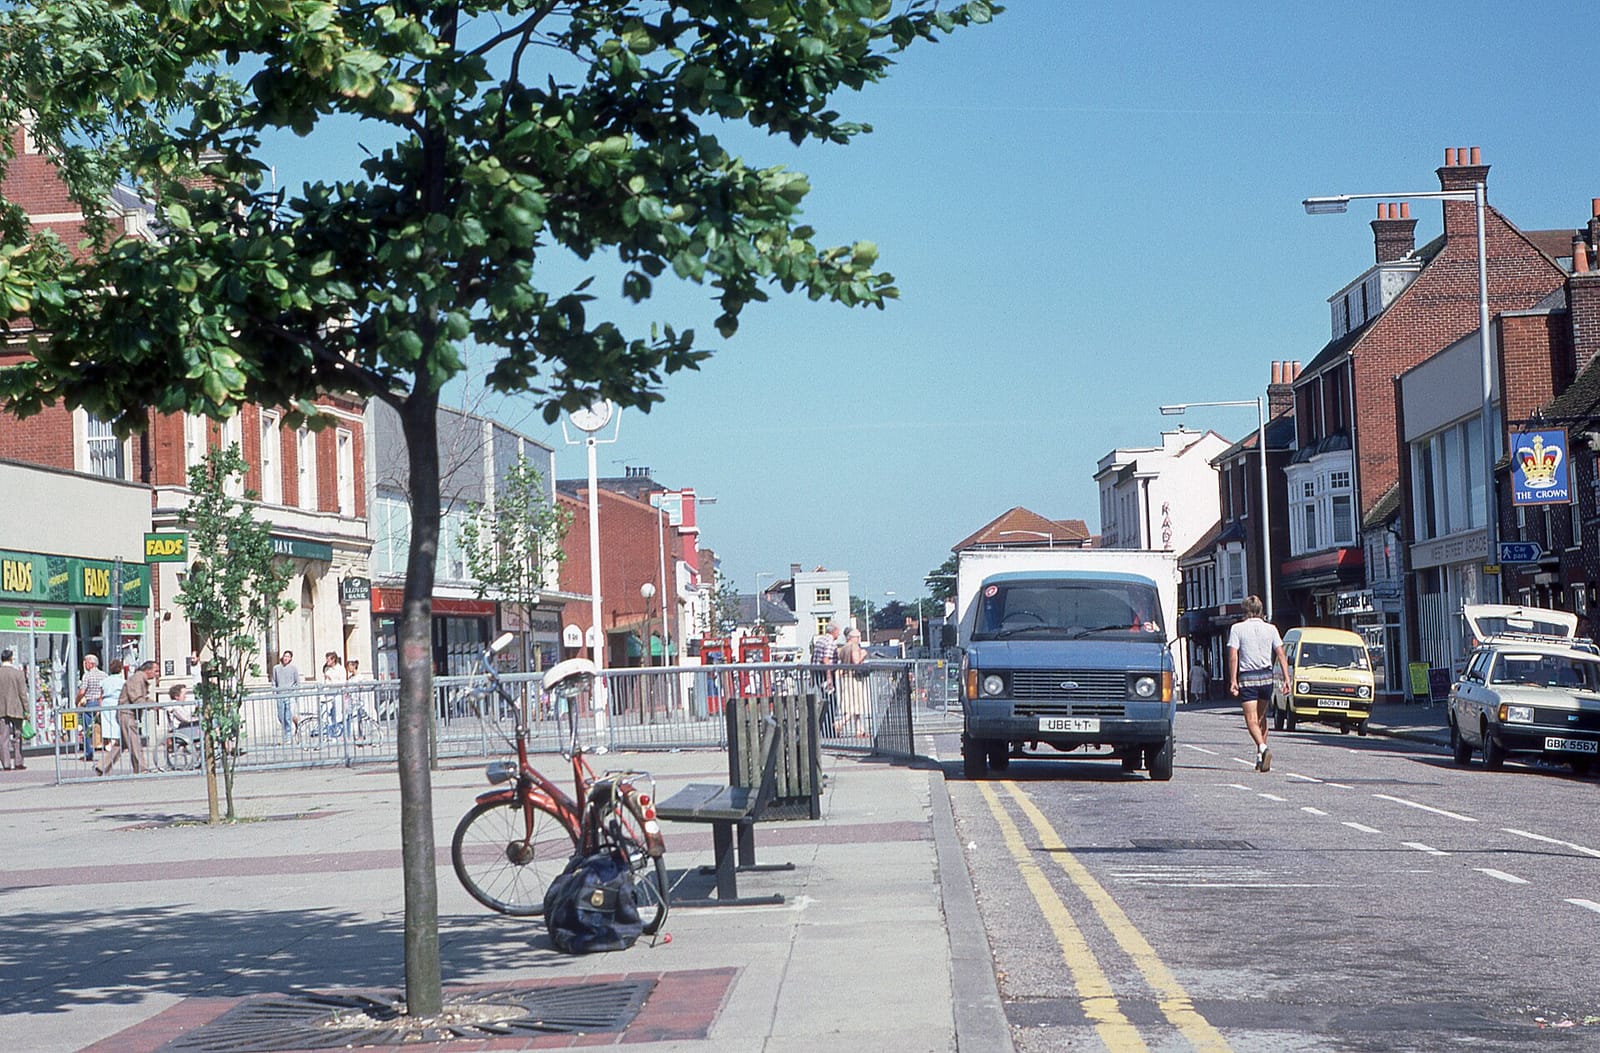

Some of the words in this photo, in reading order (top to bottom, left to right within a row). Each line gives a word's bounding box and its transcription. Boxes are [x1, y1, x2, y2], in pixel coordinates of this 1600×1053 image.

[1516, 491, 1533, 500] THE
[1536, 489, 1568, 499] CROWN
[146, 539, 183, 556] FADS
[274, 540, 293, 555] BANK
[1514, 545, 1526, 553] Car
[1513, 552, 1528, 560] park
[3, 560, 32, 592] FADS
[84, 567, 110, 598] FADS
[345, 587, 368, 595] LLOYDS
[64, 715, 75, 729] H
[1048, 719, 1072, 730] UBE
[1546, 738, 1567, 749] GBK
[1569, 741, 1598, 752] 556X
